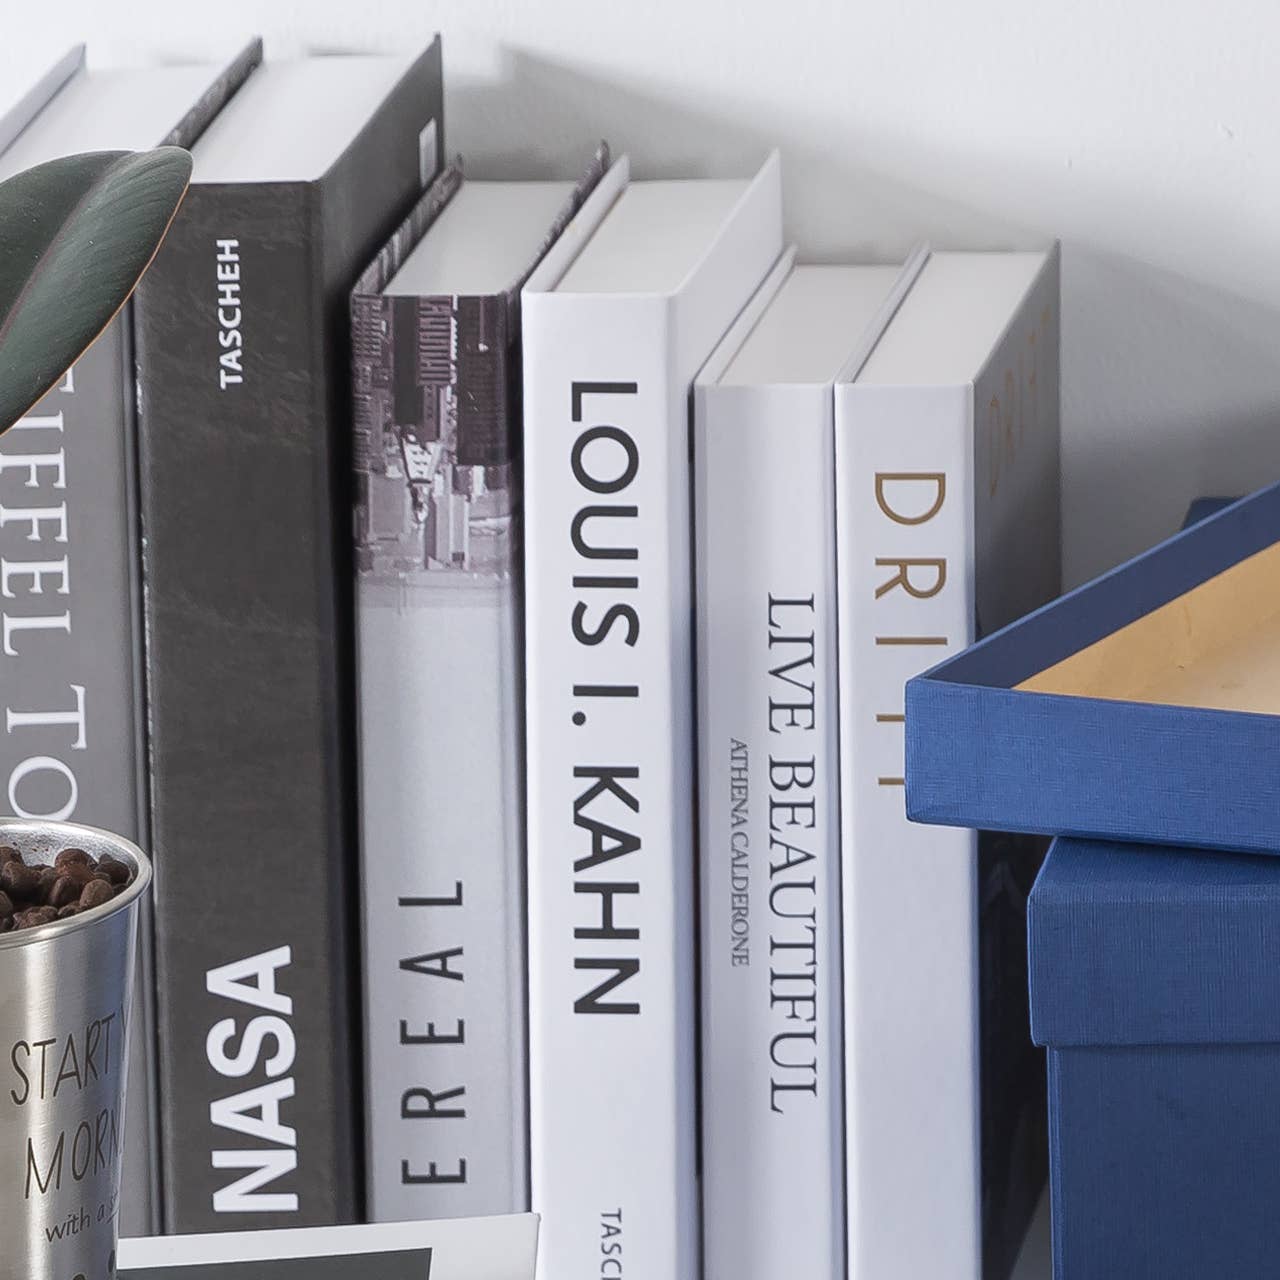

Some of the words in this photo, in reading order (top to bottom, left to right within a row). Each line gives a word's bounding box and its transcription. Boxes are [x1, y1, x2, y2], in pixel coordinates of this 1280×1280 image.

[0, 368, 75, 656] IFFEL
[571, 381, 640, 648] LOUIS
[572, 684, 639, 727] I.
[768, 592, 815, 734] LIVE
[874, 472, 949, 786] DRI
[730, 737, 748, 828] ATHENA
[573, 766, 642, 1015] KAHN
[730, 831, 750, 967] CALDERONE
[768, 754, 817, 1114] BEAUTIFUL
[10, 1012, 116, 1106] START
[206, 945, 299, 1212] NASA
[45, 1207, 92, 1243] with
